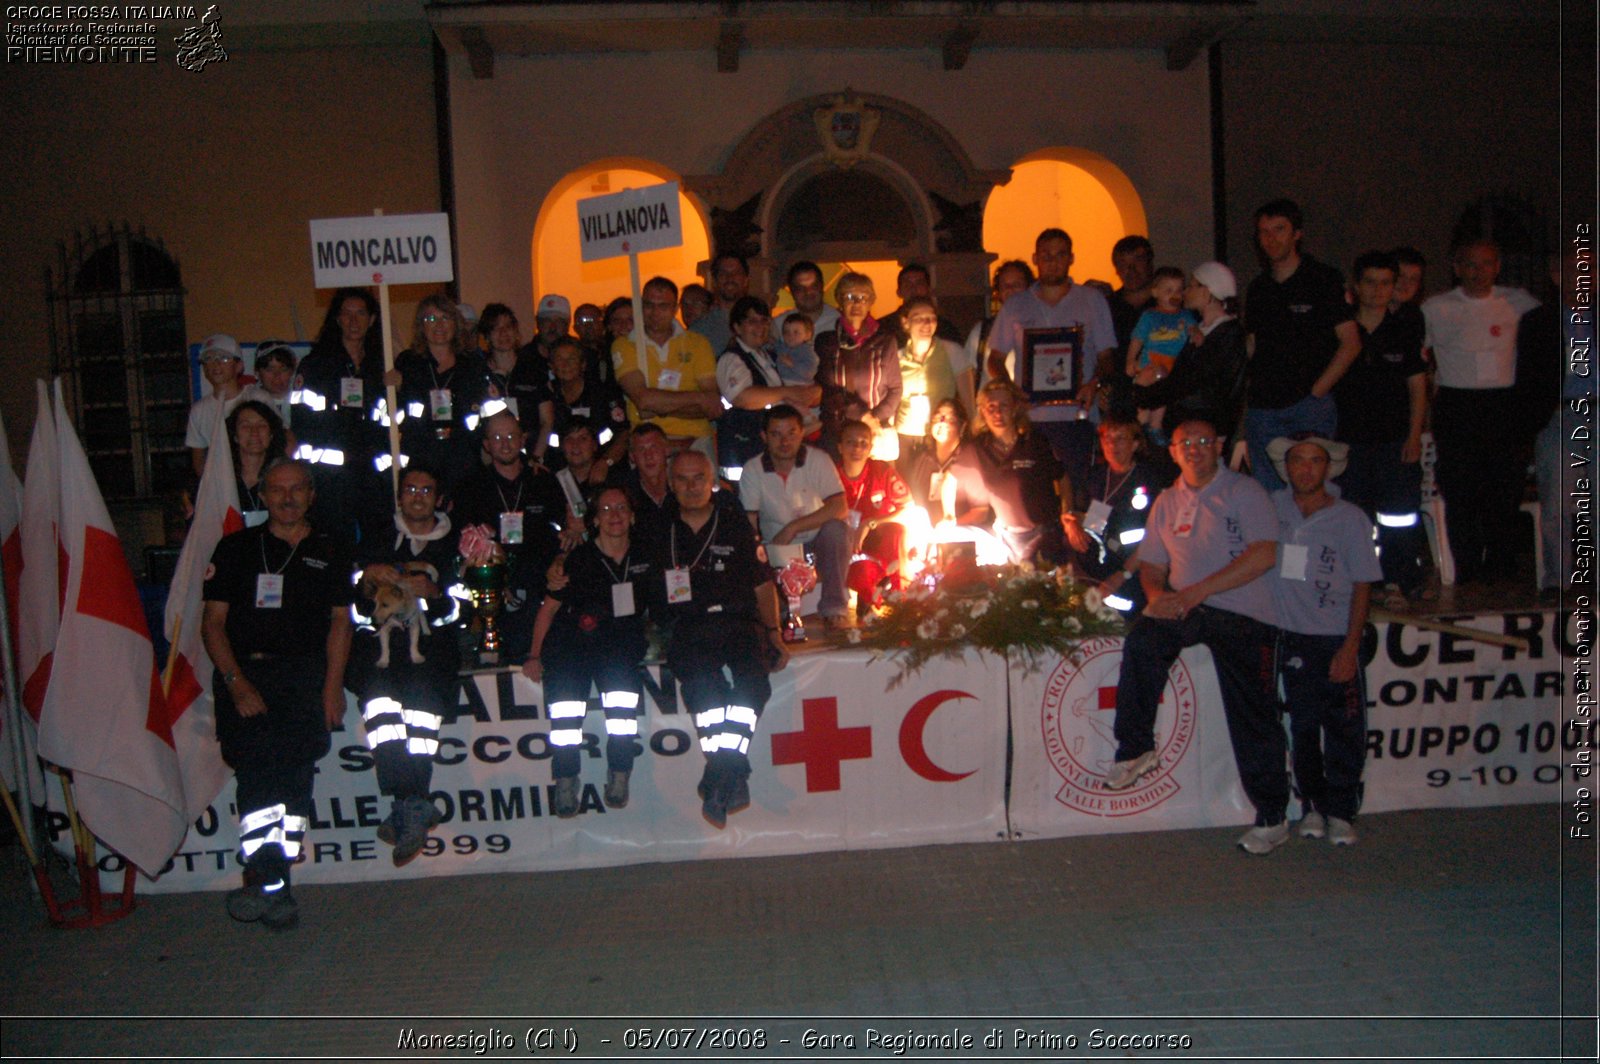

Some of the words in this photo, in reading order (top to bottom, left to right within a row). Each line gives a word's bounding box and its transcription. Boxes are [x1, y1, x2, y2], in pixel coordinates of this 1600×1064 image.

[581, 201, 671, 243] VILLANOVA
[315, 235, 438, 270] MONCALVO
[1064, 788, 1107, 811] VALLE
[1110, 780, 1174, 812] BORMIDA
